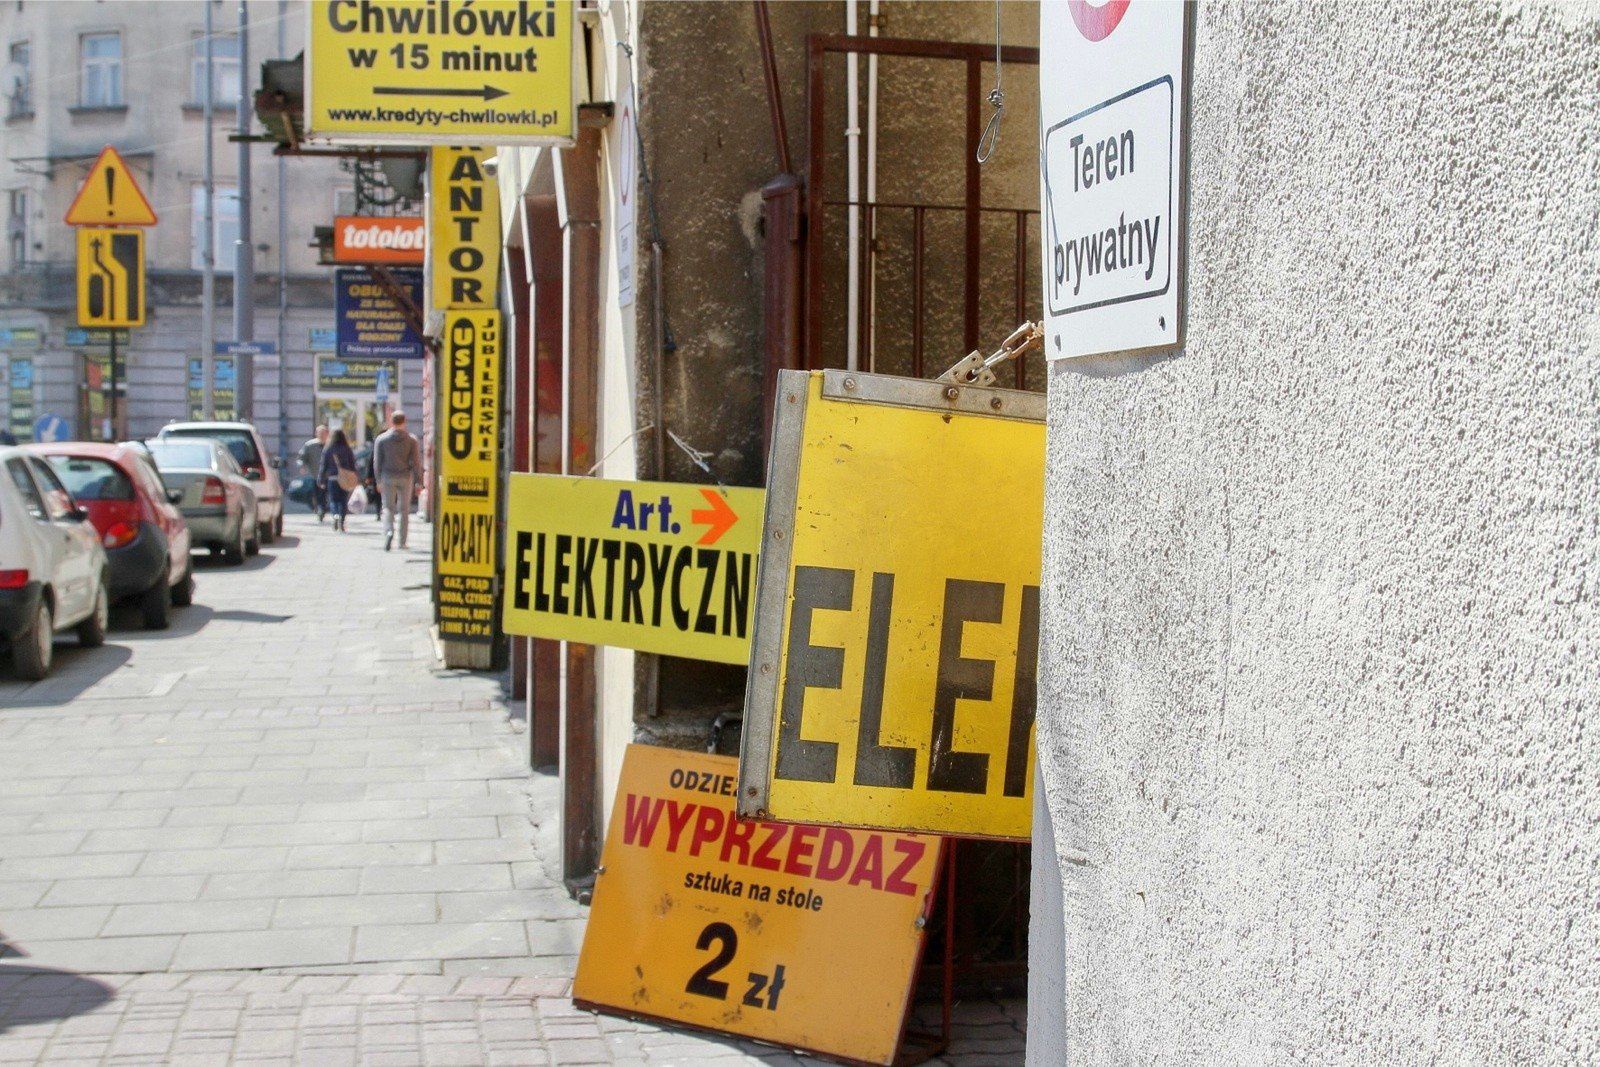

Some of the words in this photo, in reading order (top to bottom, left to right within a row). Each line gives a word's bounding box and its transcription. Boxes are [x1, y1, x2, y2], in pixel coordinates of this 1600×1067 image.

[328, 0, 556, 37] Chwilówki
[348, 48, 377, 68] w
[390, 43, 430, 69] 15
[441, 46, 538, 72] minut
[1070, 128, 1135, 193] Teren
[343, 225, 424, 250] totolot
[448, 146, 484, 303] ANTOR
[1054, 211, 1161, 300] prywatny
[450, 327, 473, 452] USŁUGI
[478, 318, 495, 461] JUBILERSKIE
[441, 511, 493, 564] OPŁATY
[611, 489, 681, 534] Art.
[514, 531, 759, 639] ELEKTRYCZN
[684, 870, 743, 897] sztuka
[748, 882, 770, 902] na
[776, 886, 824, 912] stole
[685, 921, 739, 1001] 2
[743, 964, 786, 1011] zł
